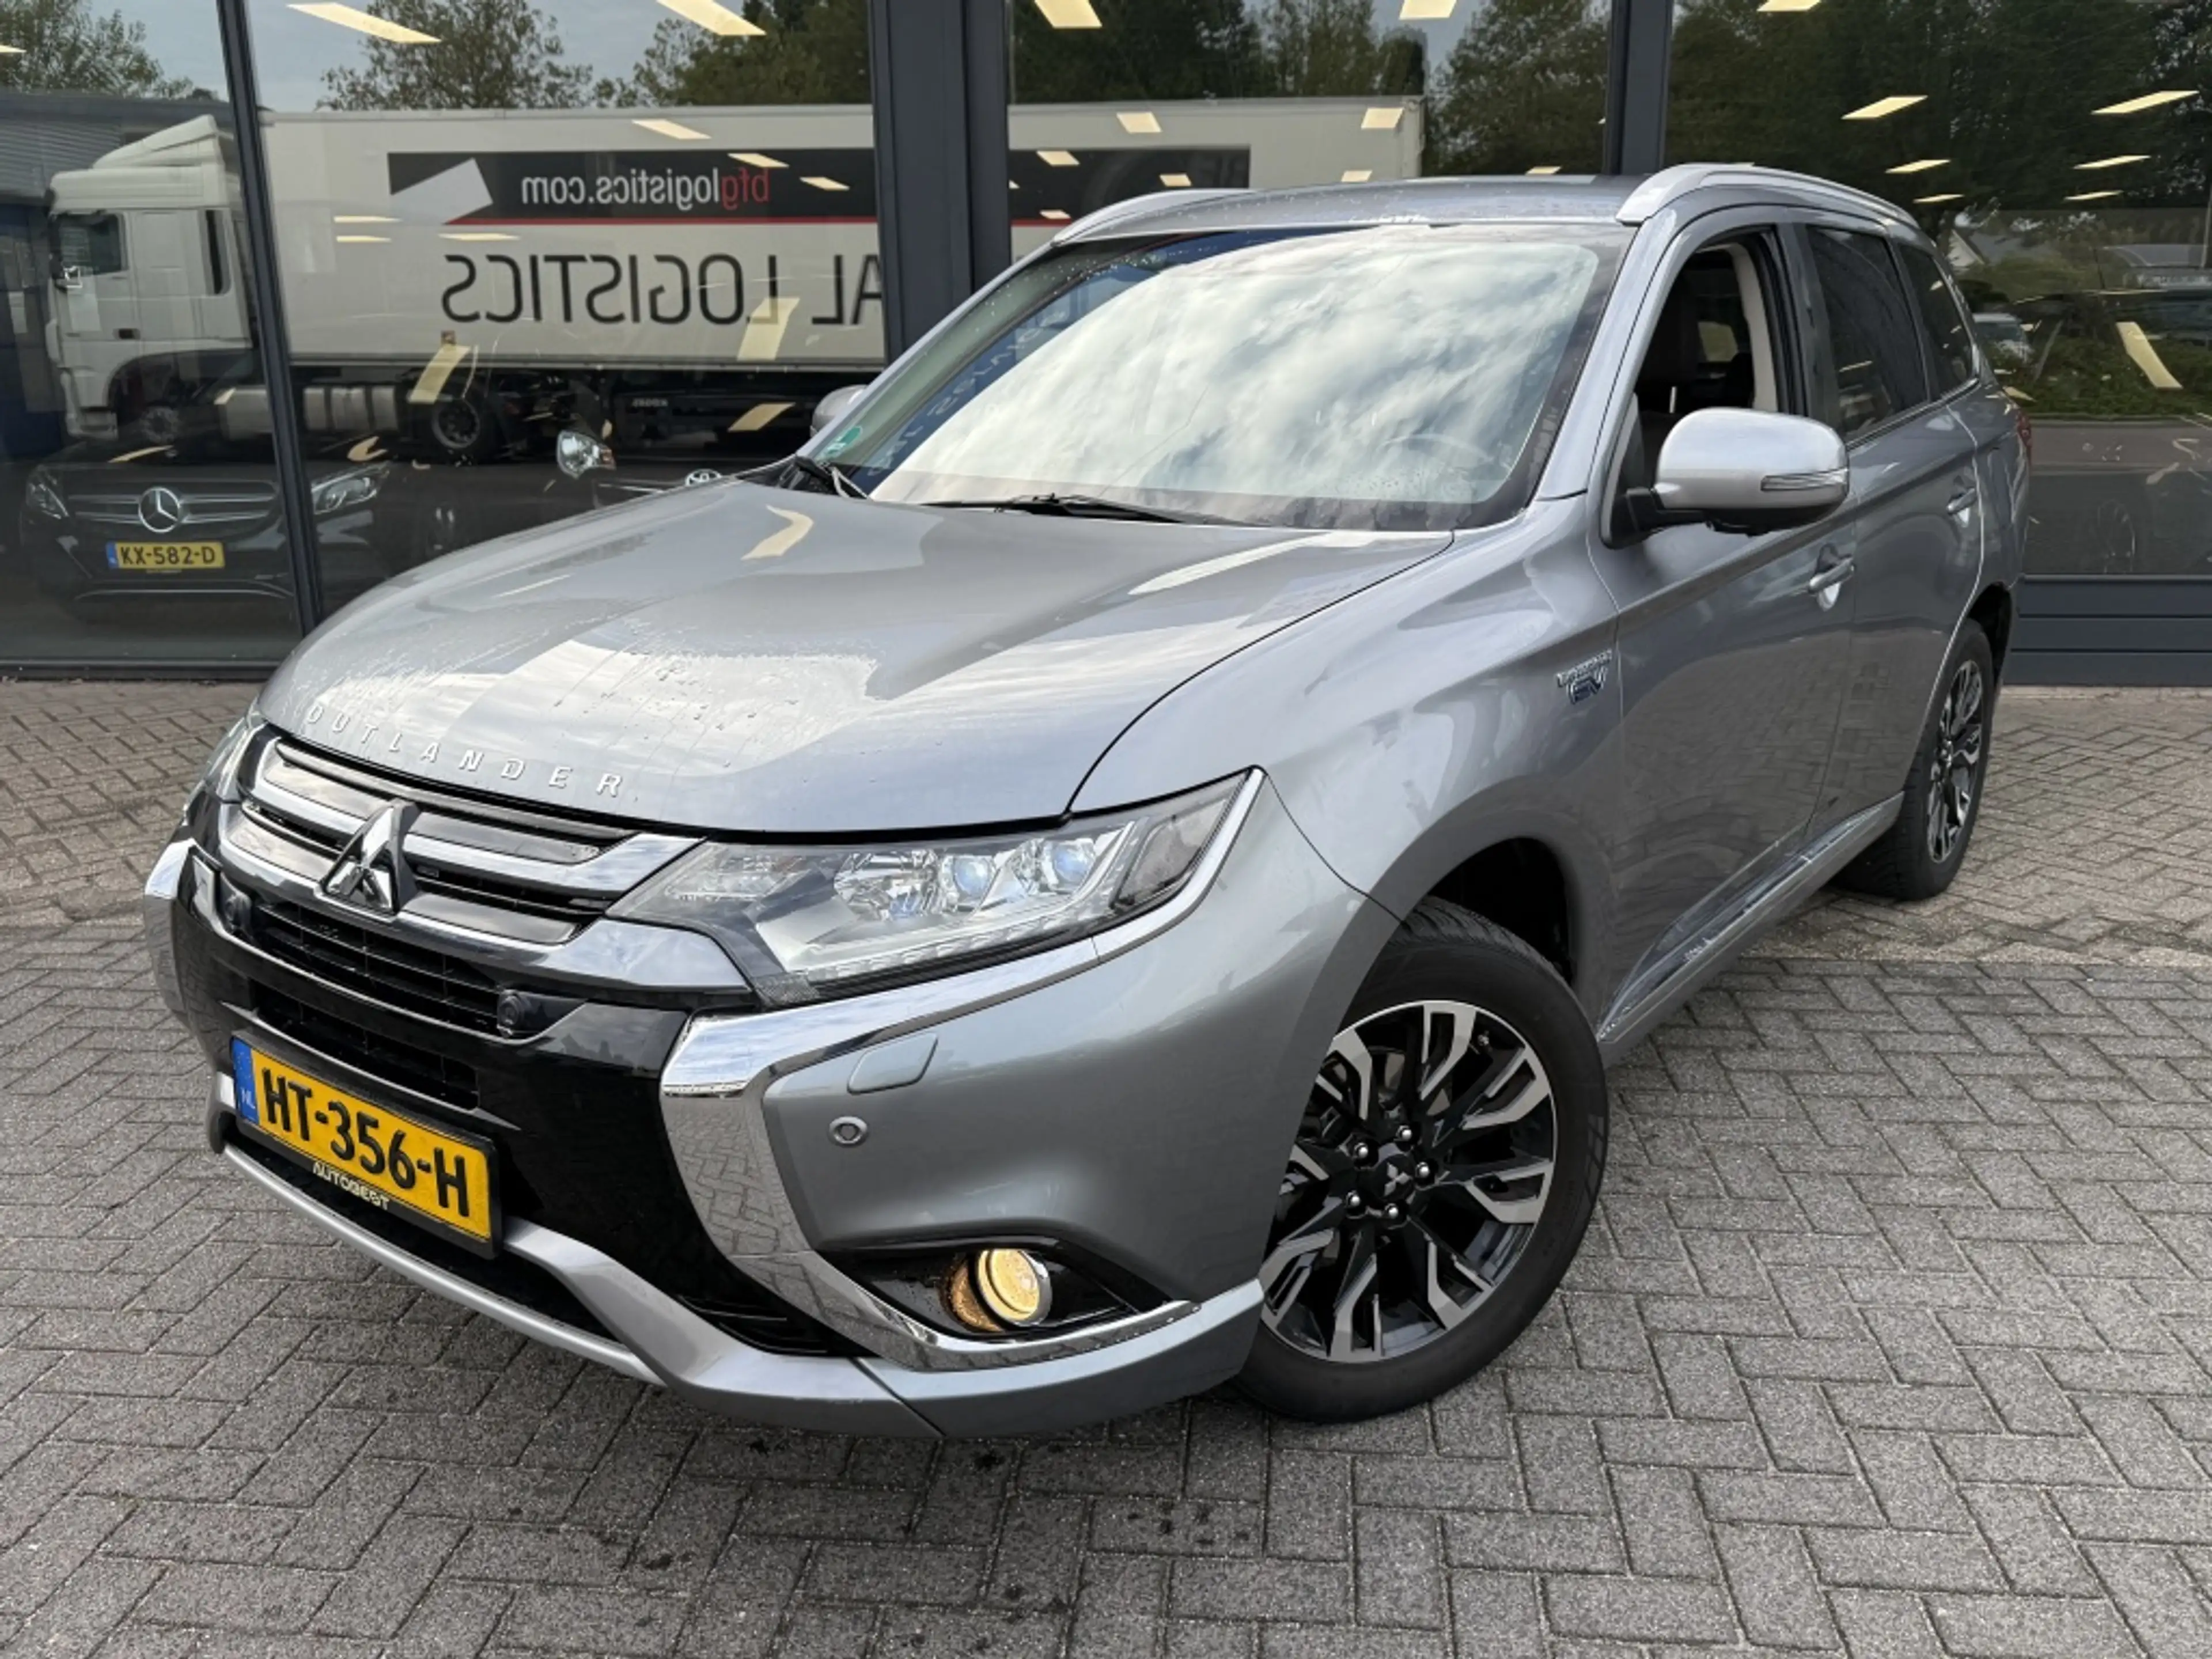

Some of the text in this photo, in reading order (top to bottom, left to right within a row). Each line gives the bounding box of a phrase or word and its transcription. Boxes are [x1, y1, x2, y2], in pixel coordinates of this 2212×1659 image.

[120, 546, 216, 565] KX-582-D
[306, 701, 623, 797] OUTLANDER
[261, 1067, 470, 1218] HT-356-H
[312, 1161, 391, 1210] AUTOBEST
